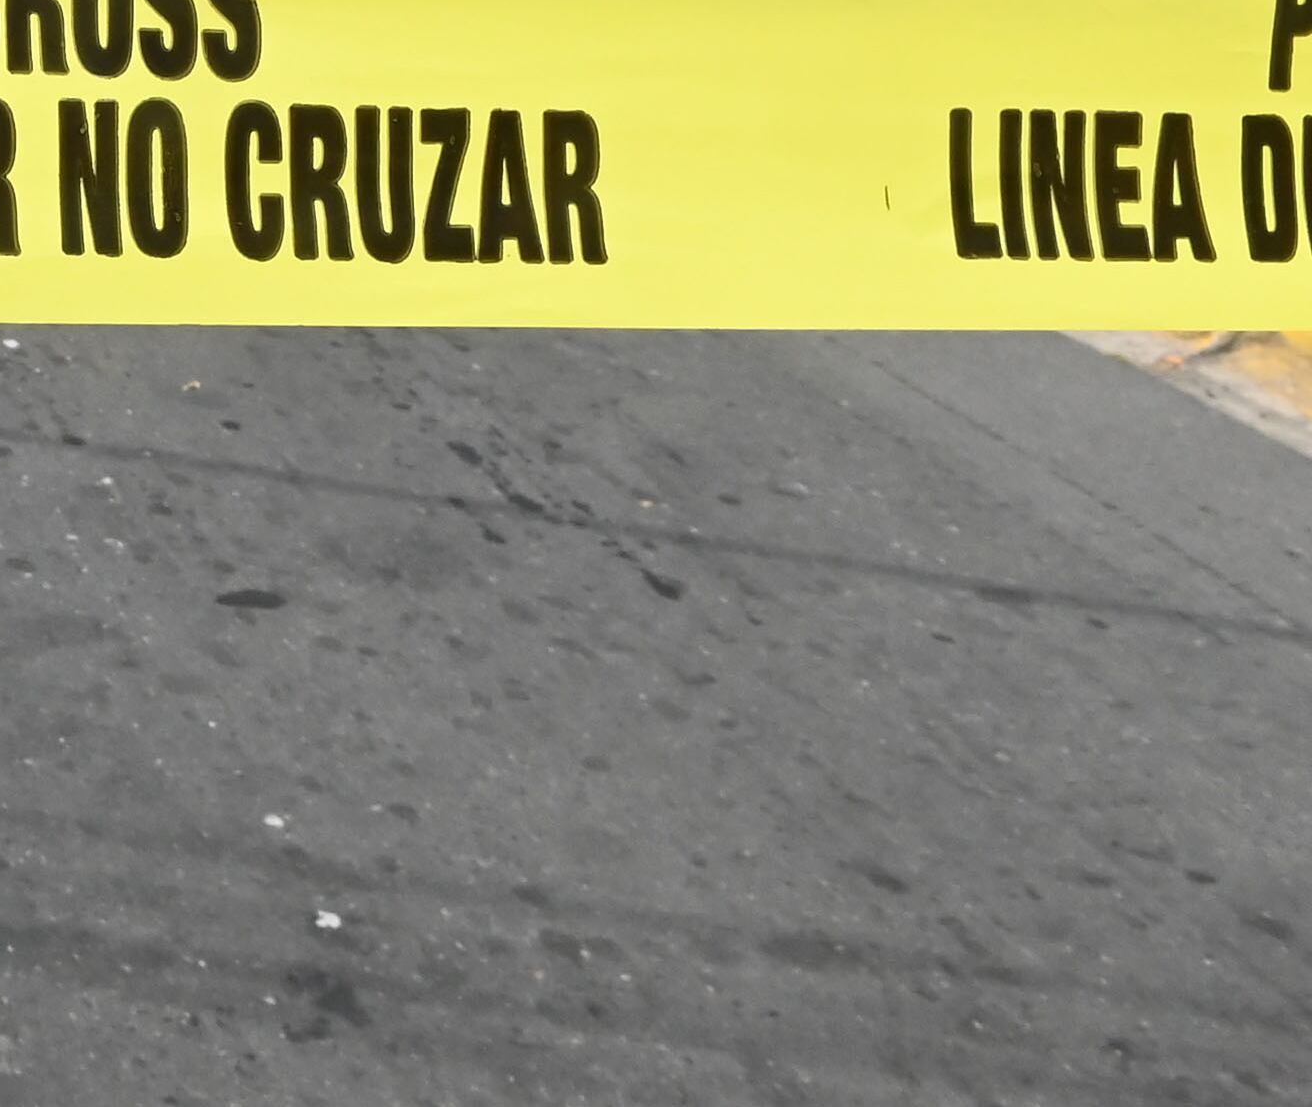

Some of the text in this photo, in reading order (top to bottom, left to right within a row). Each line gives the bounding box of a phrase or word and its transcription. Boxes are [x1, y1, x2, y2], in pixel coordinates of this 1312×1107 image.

[57, 99, 190, 260] NO
[224, 102, 609, 265] CRUZAR
[949, 107, 1312, 263] LINEA D
